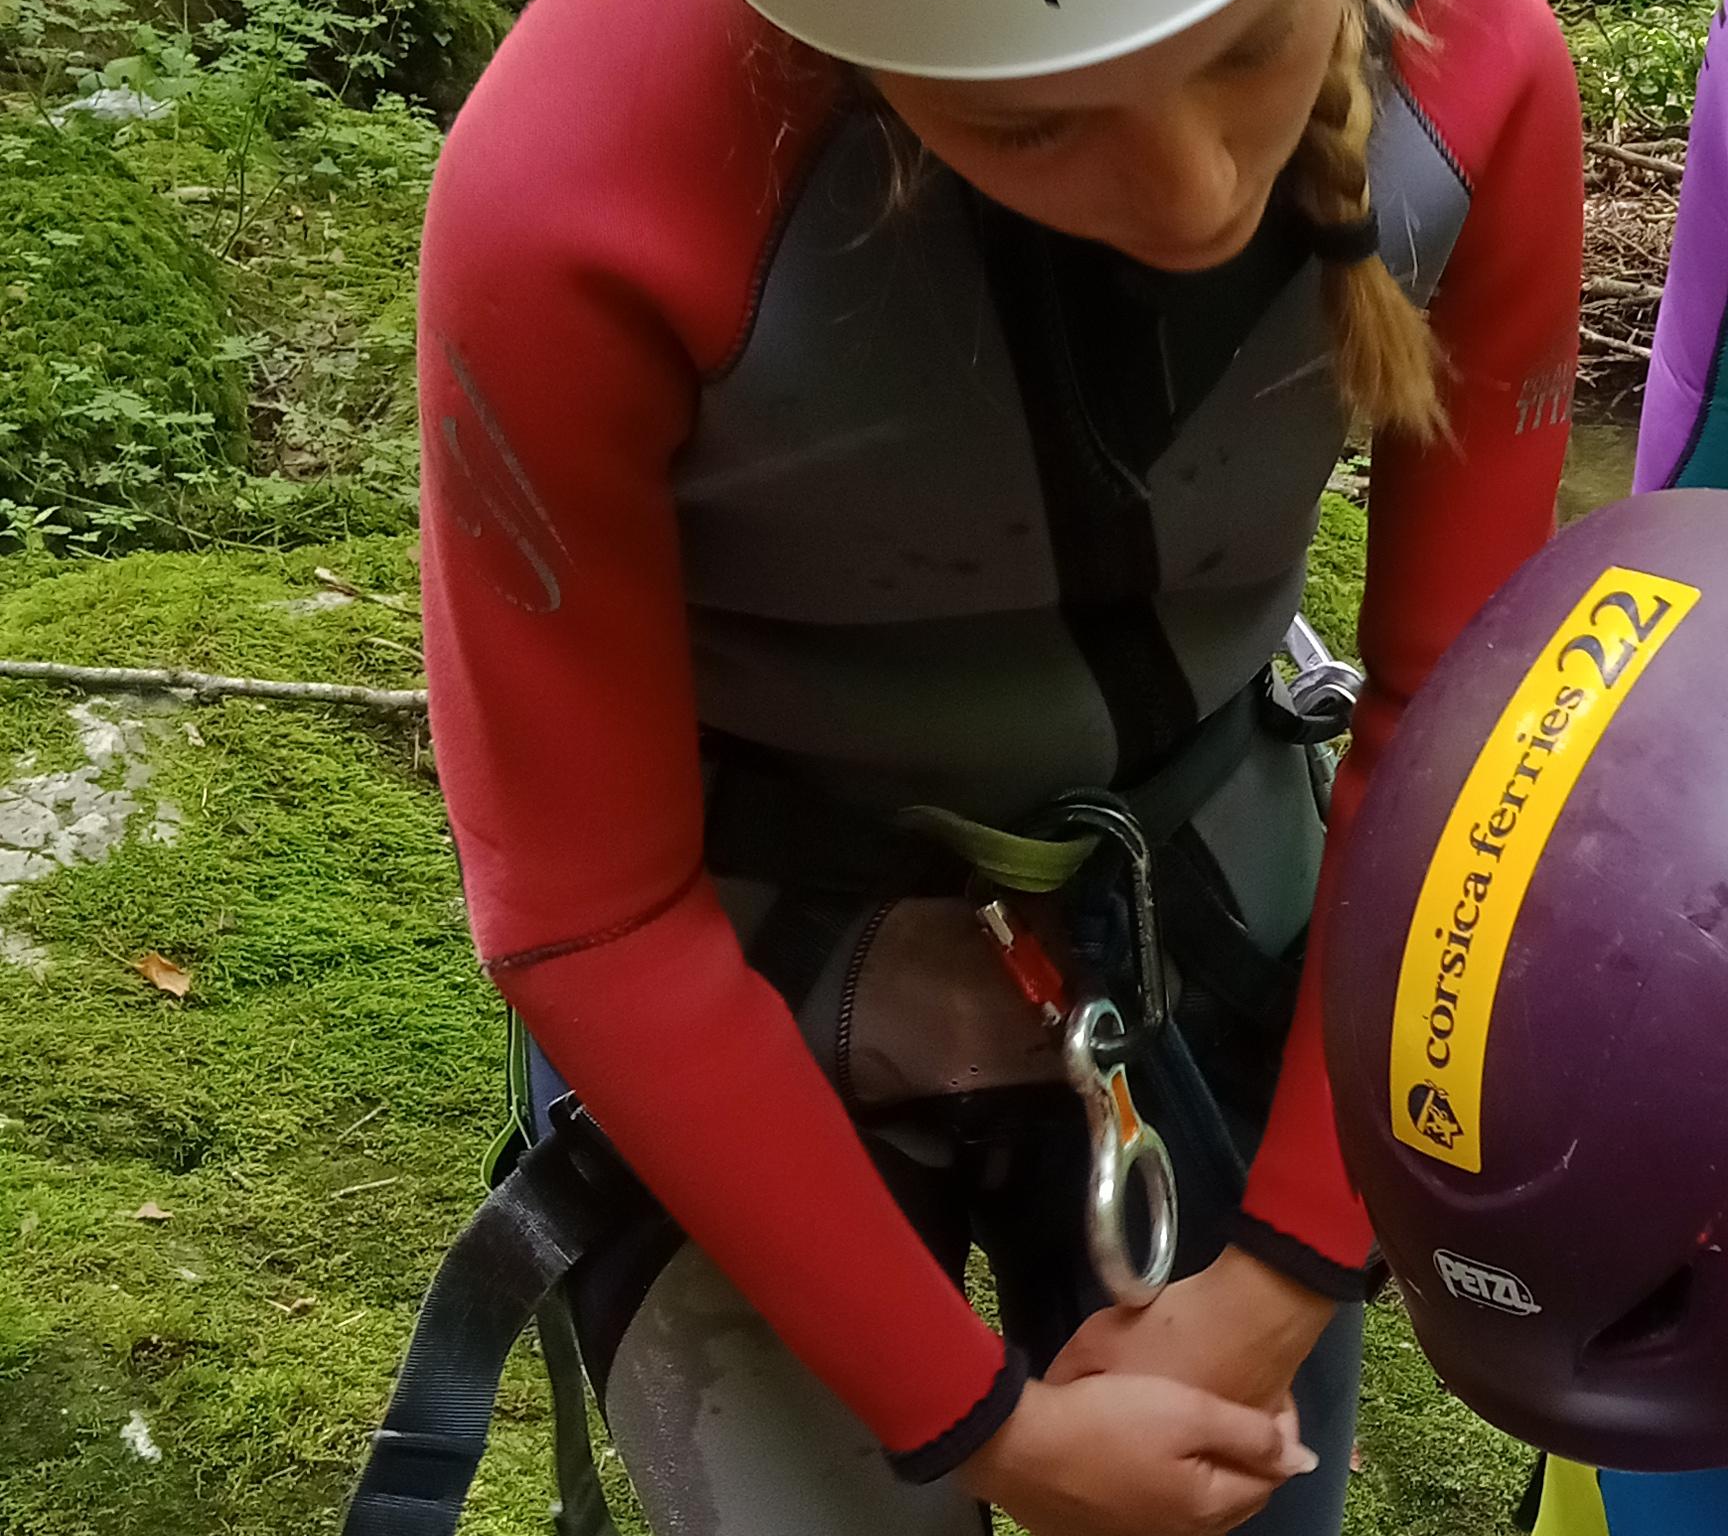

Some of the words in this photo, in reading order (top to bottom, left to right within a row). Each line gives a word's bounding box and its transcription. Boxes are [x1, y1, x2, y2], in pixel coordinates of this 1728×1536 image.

[1426, 871, 1493, 1069] corsica
[1469, 685, 1585, 863] ferries
[1557, 591, 1672, 689] 22
[1436, 1253, 1543, 1314] PETZL
